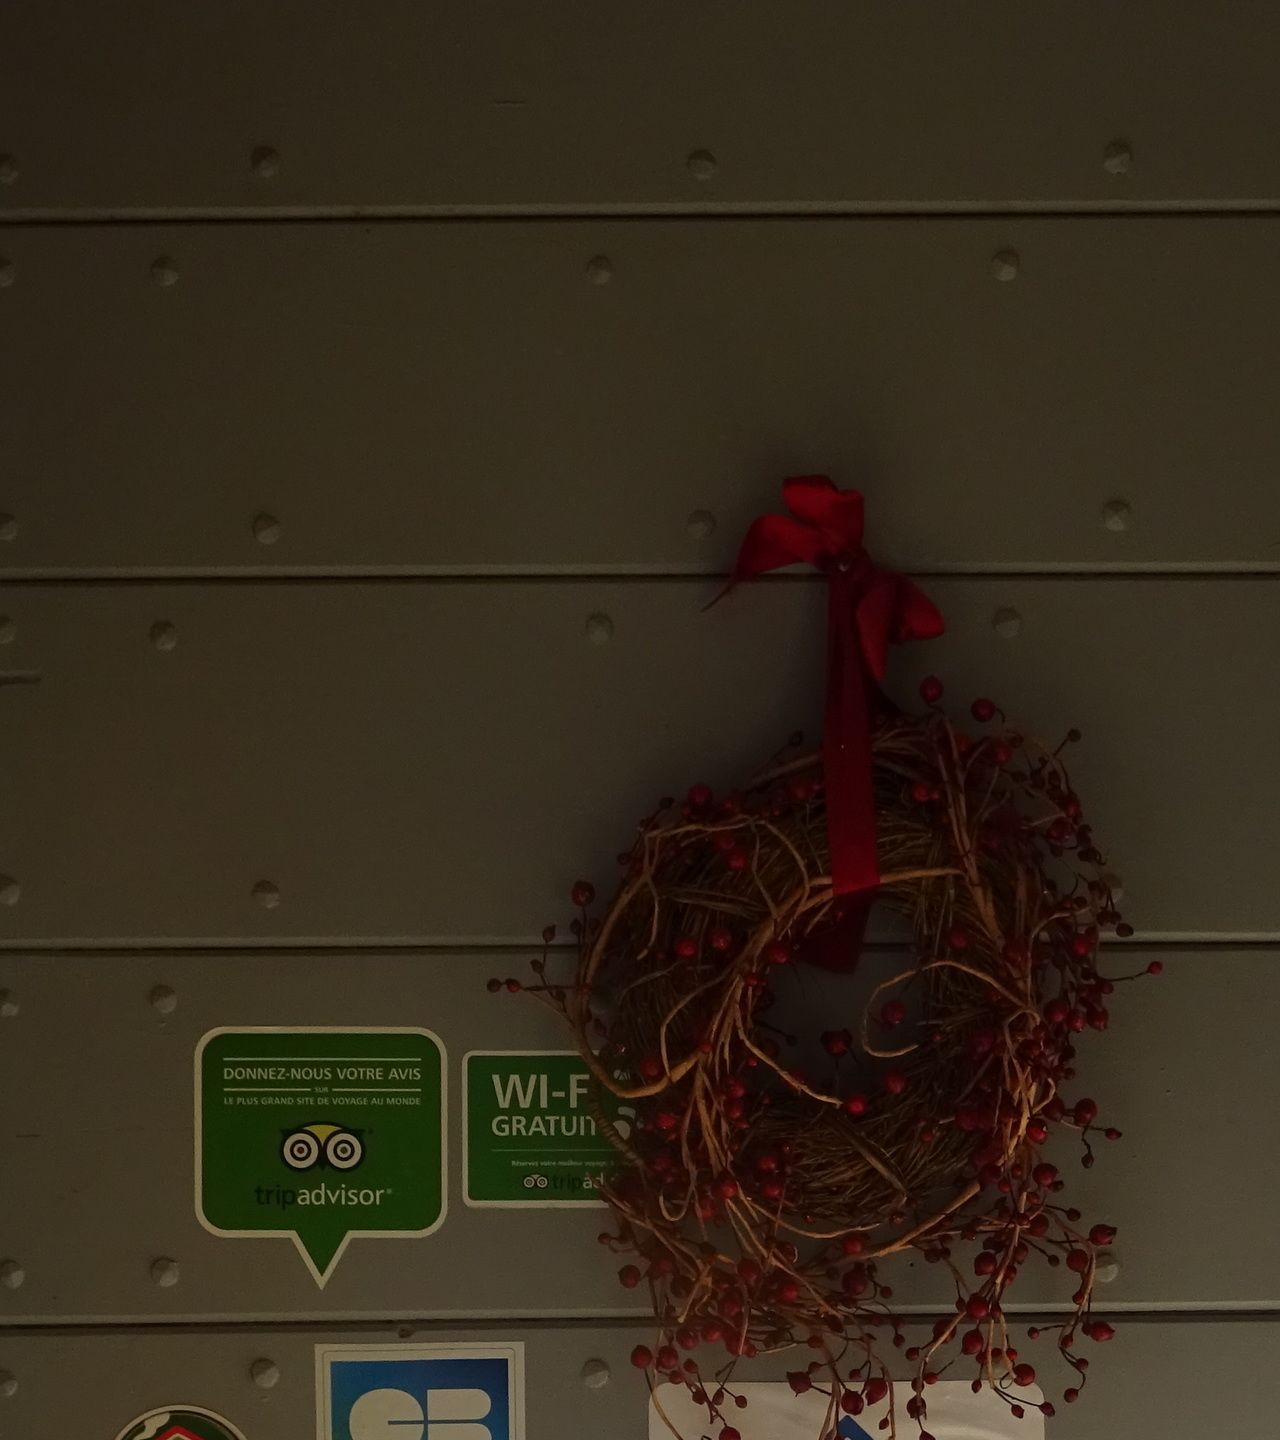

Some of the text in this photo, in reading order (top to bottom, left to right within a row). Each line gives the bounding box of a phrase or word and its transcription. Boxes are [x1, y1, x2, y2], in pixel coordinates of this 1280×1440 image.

[223, 1067, 422, 1081] DONNEZ-NOUS VOTRE AVIS
[223, 1097, 421, 1105] LE PLUS GRAND SITE DE VOYAGE AU MONDE
[491, 1073, 591, 1109] WI-F
[254, 1183, 386, 1211] tripadvisor
